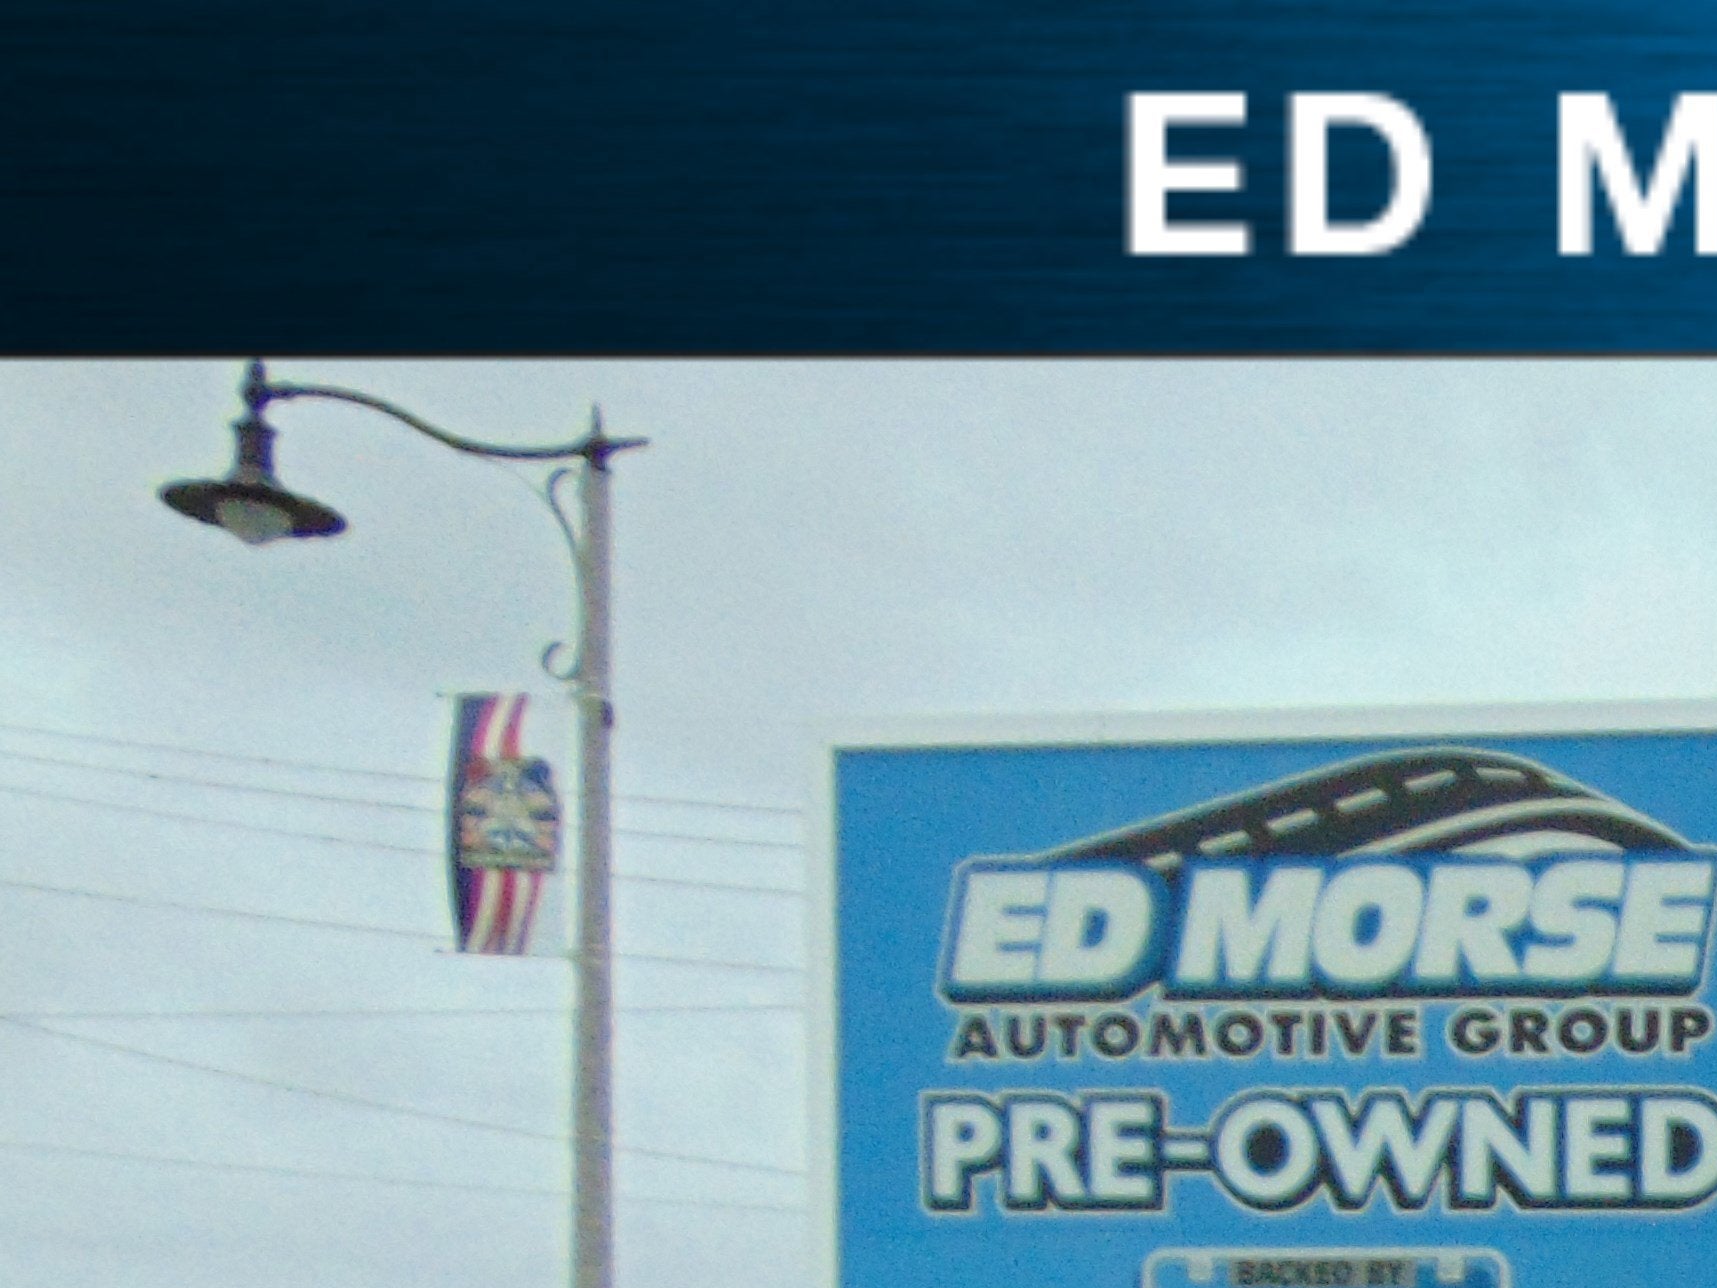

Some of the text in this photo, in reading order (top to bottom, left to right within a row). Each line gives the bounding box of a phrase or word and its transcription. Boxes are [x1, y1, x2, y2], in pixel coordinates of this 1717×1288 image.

[950, 862, 1714, 984] ED MORSE
[954, 1006, 1712, 1058] AUTOMOTIVE GROUP
